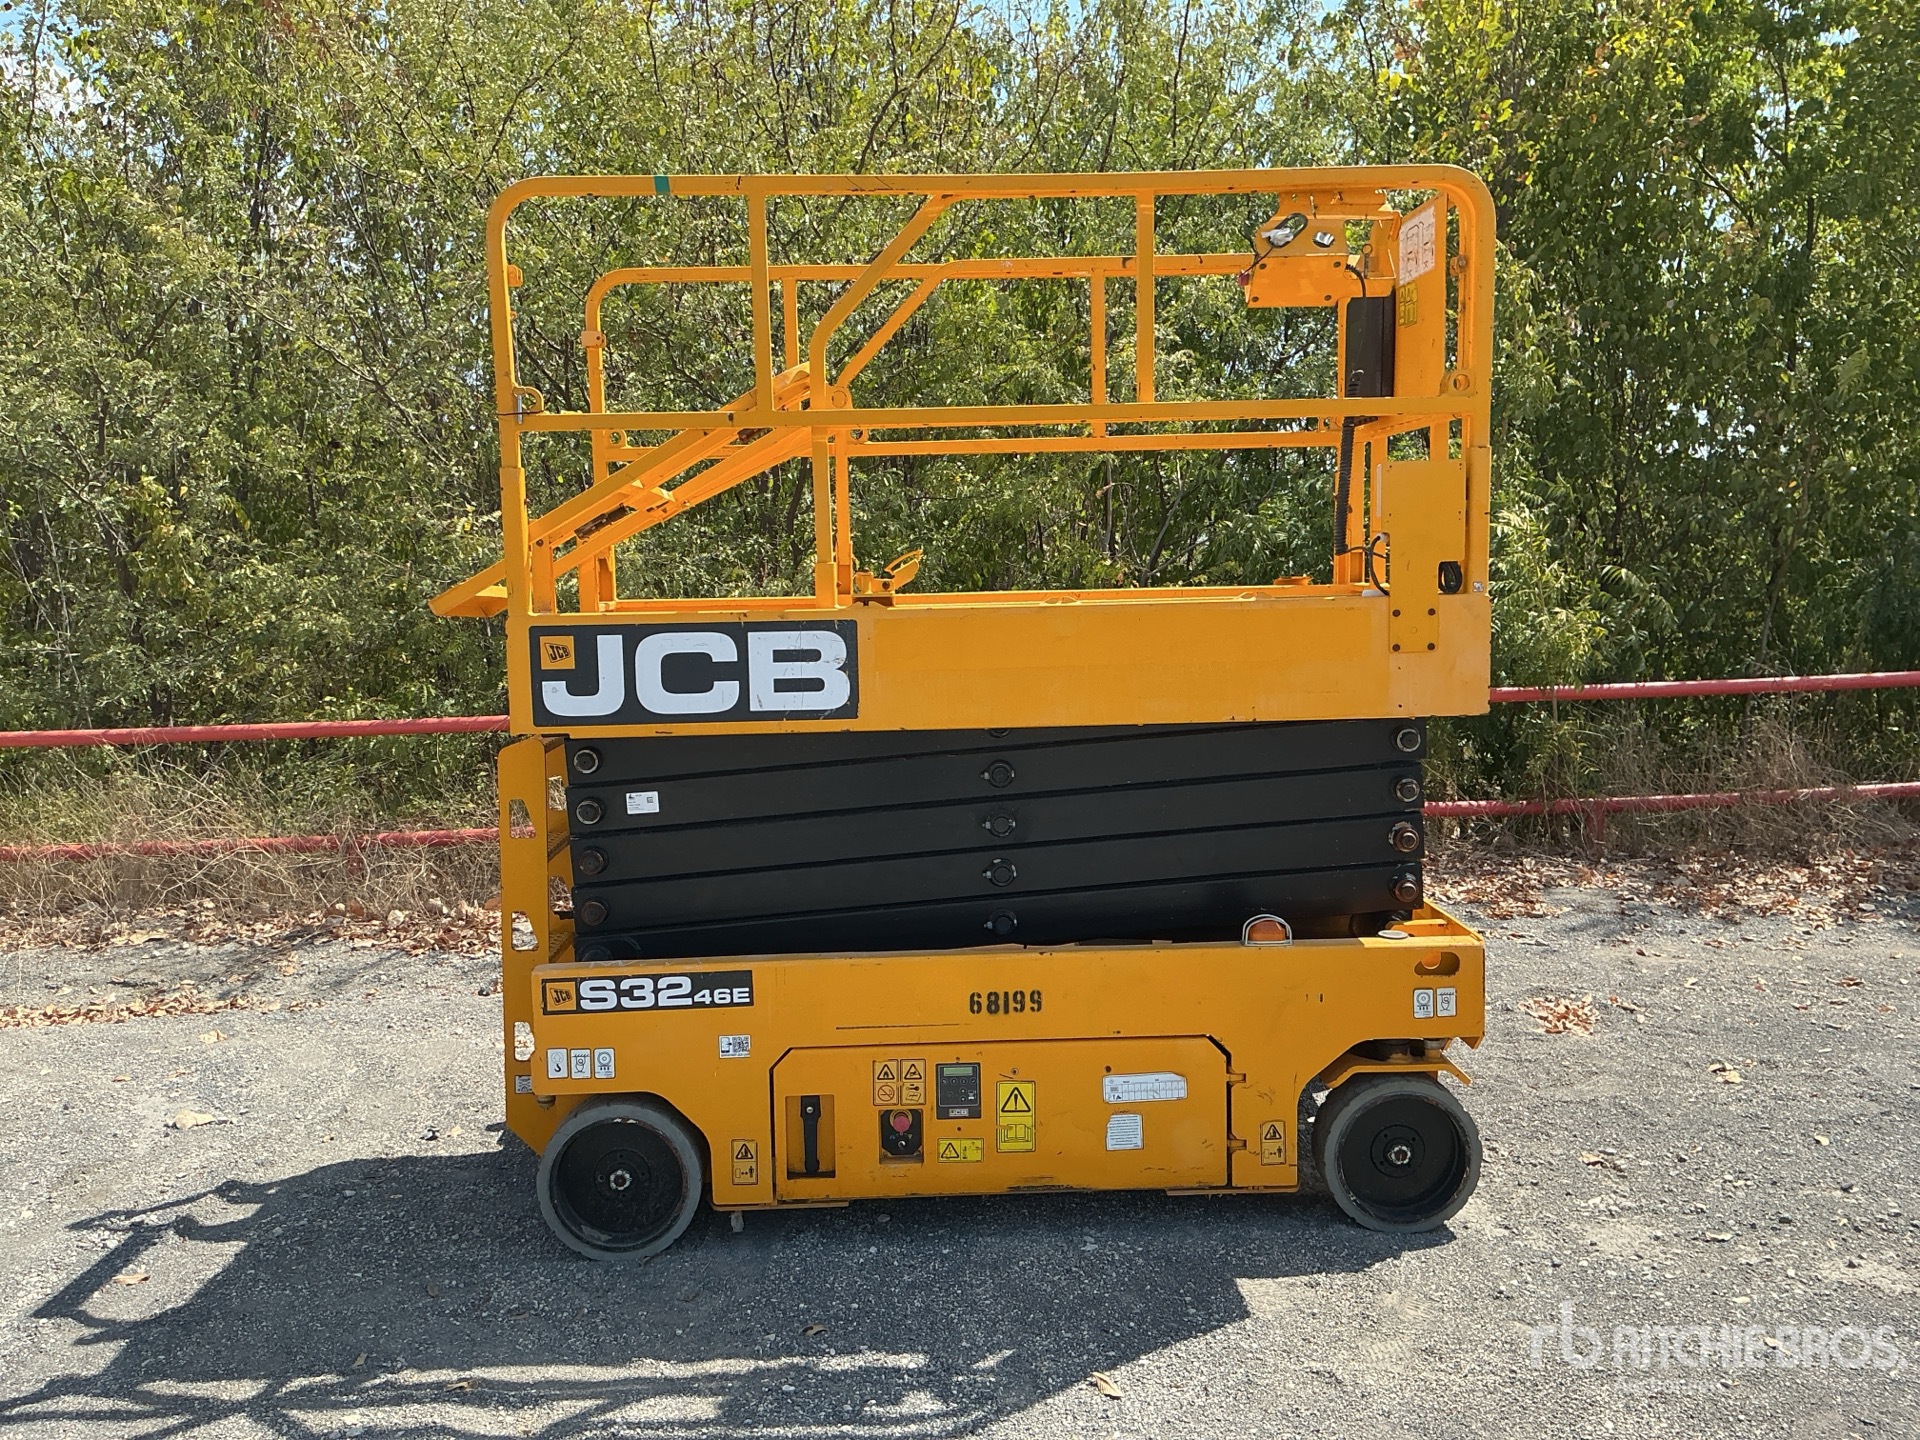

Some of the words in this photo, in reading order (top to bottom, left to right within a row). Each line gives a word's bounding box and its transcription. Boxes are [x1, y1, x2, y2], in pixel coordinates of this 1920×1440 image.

[547, 643, 571, 662] JCB
[542, 631, 850, 716] JCB
[551, 988, 573, 1006] JCB
[969, 990, 1042, 1014] 68199
